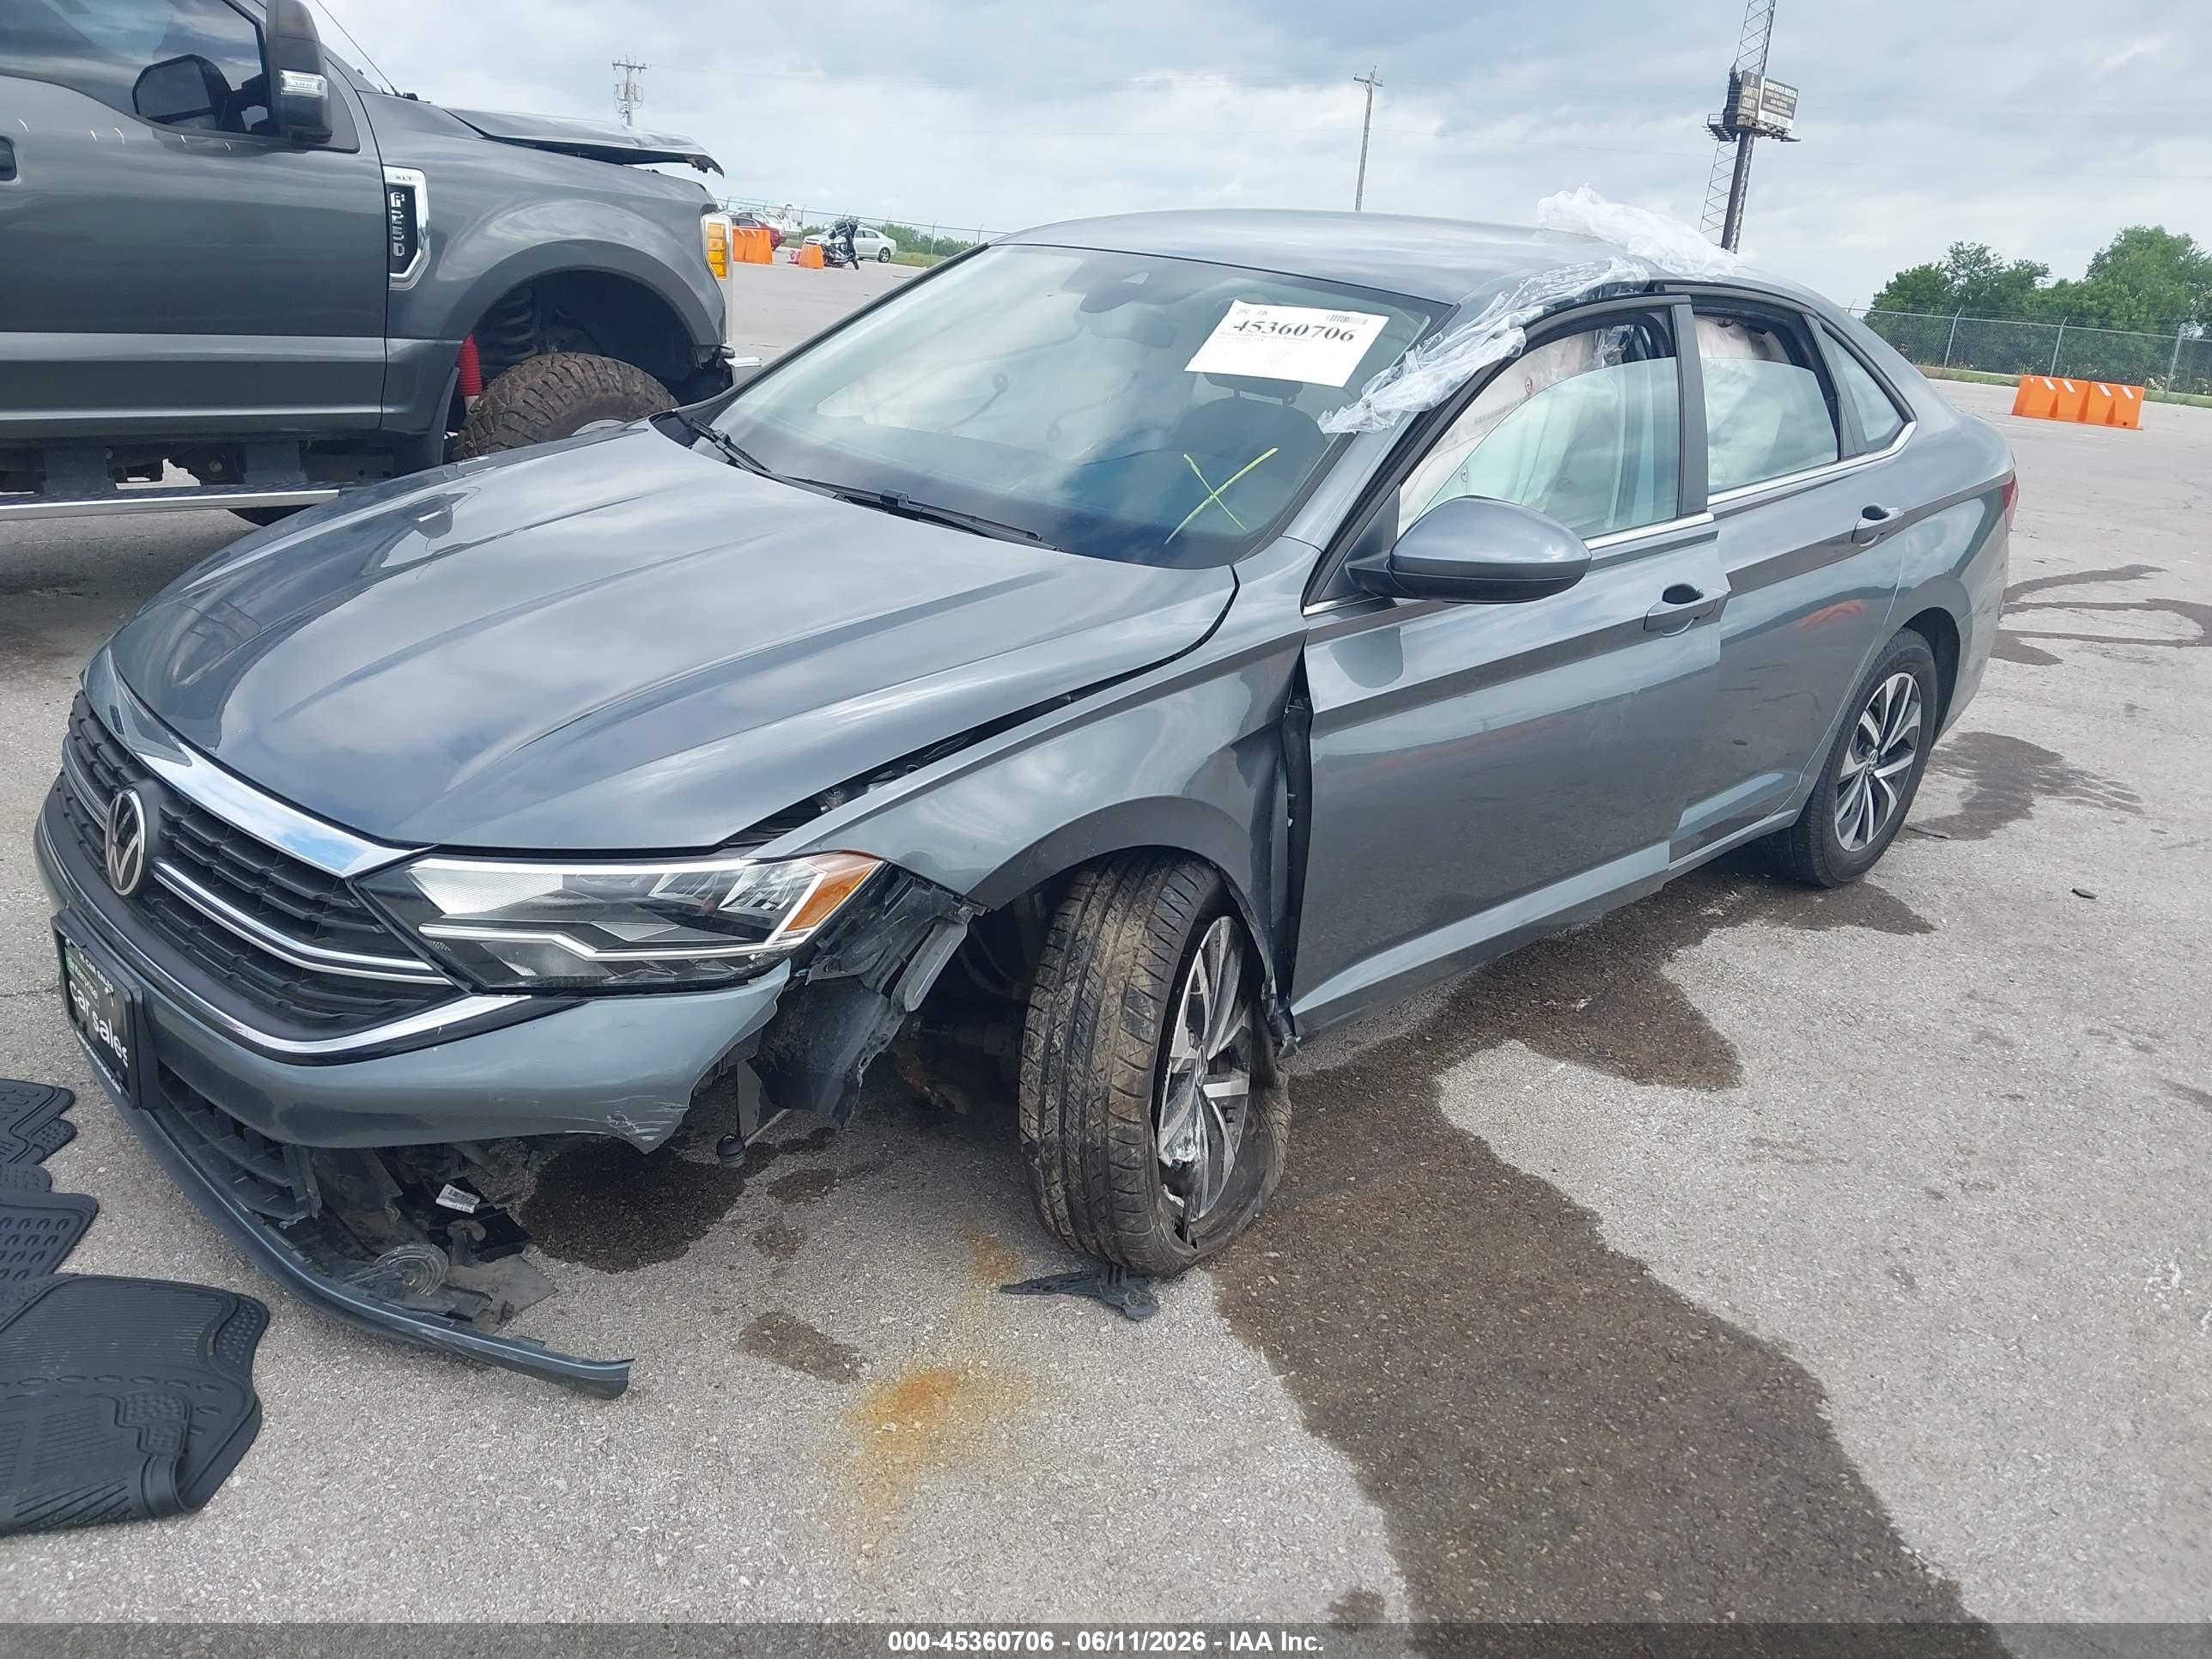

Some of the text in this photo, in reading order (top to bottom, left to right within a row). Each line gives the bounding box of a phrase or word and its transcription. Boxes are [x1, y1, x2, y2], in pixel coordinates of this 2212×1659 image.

[1233, 319, 1358, 343] 45360706
[69, 980, 129, 1068] car sales
